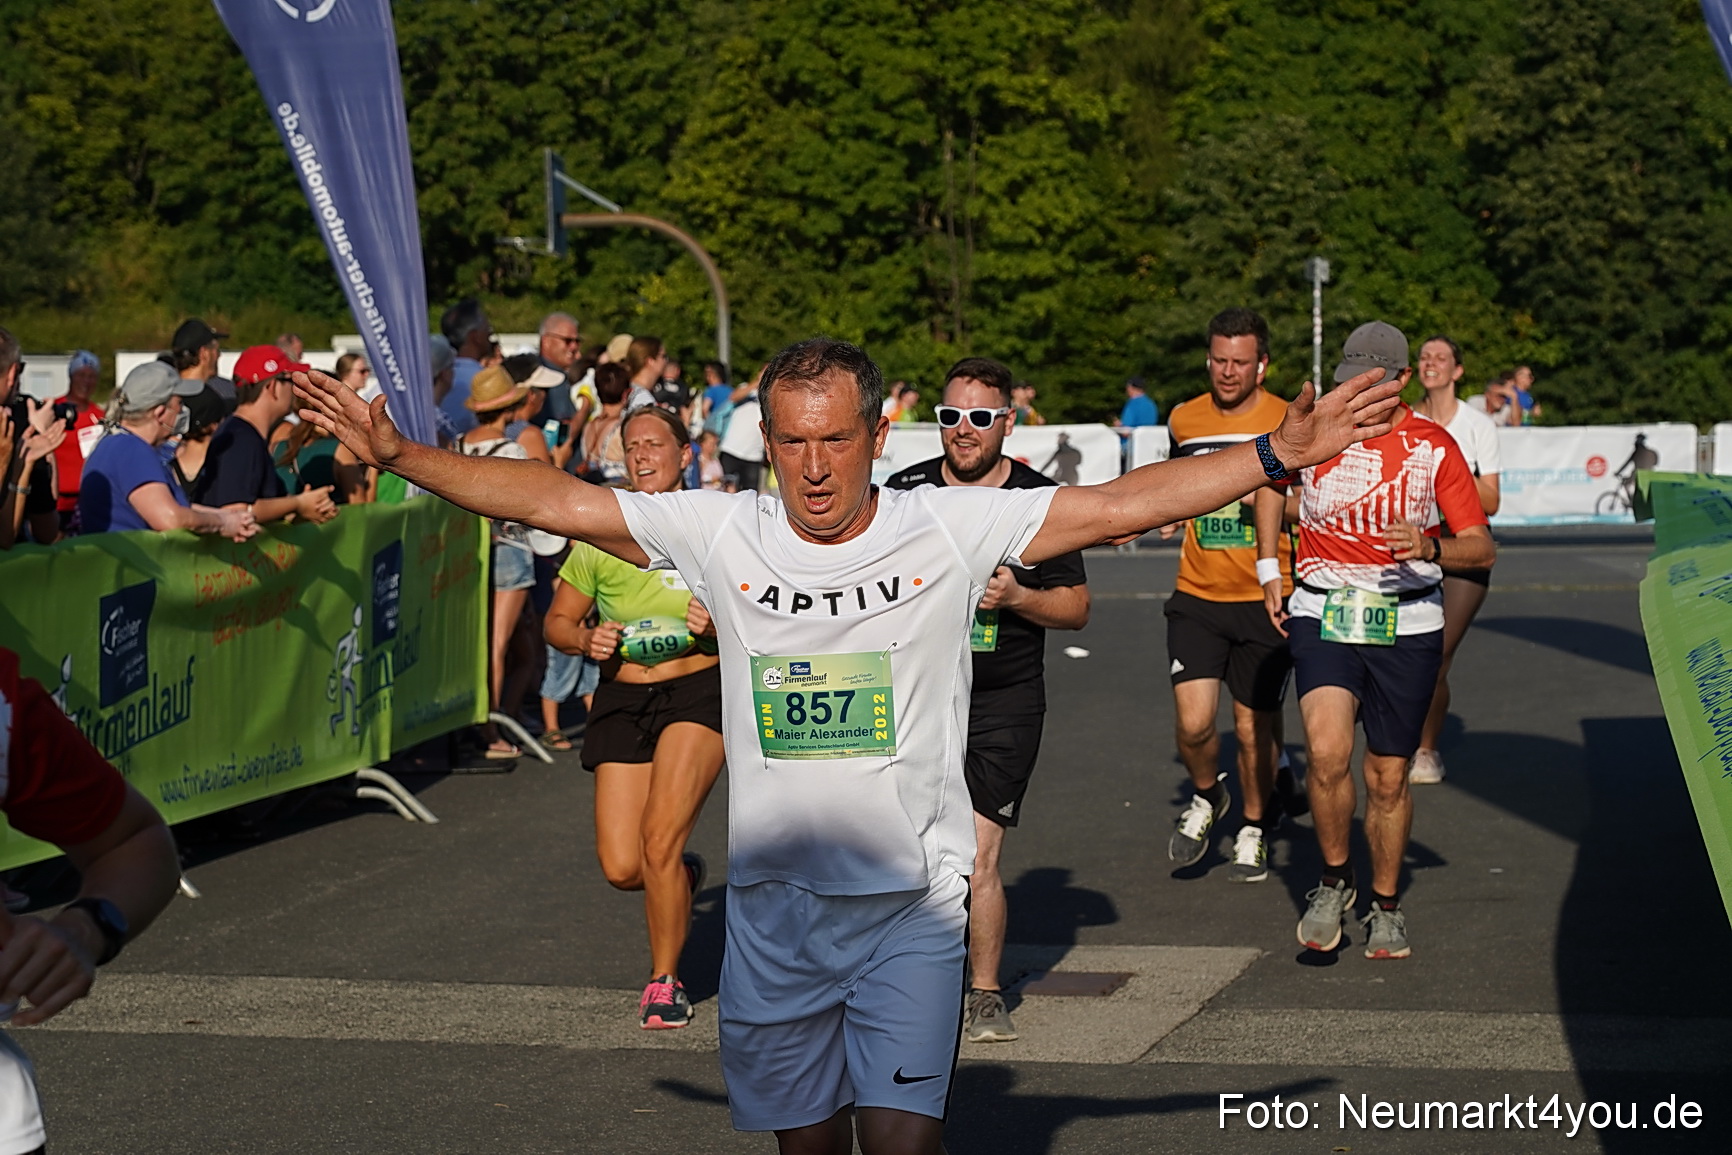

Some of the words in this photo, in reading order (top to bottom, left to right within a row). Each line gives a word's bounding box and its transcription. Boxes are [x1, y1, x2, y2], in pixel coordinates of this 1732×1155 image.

[1202, 517, 1242, 533] 1861
[757, 576, 900, 616] APTIV
[637, 635, 678, 654] 169
[784, 673, 828, 684] Firmenlauf
[761, 703, 775, 738] RUN
[786, 690, 856, 725] 857
[873, 693, 888, 741] 2022
[774, 729, 806, 740] Maier
[809, 727, 875, 740] Alexander
